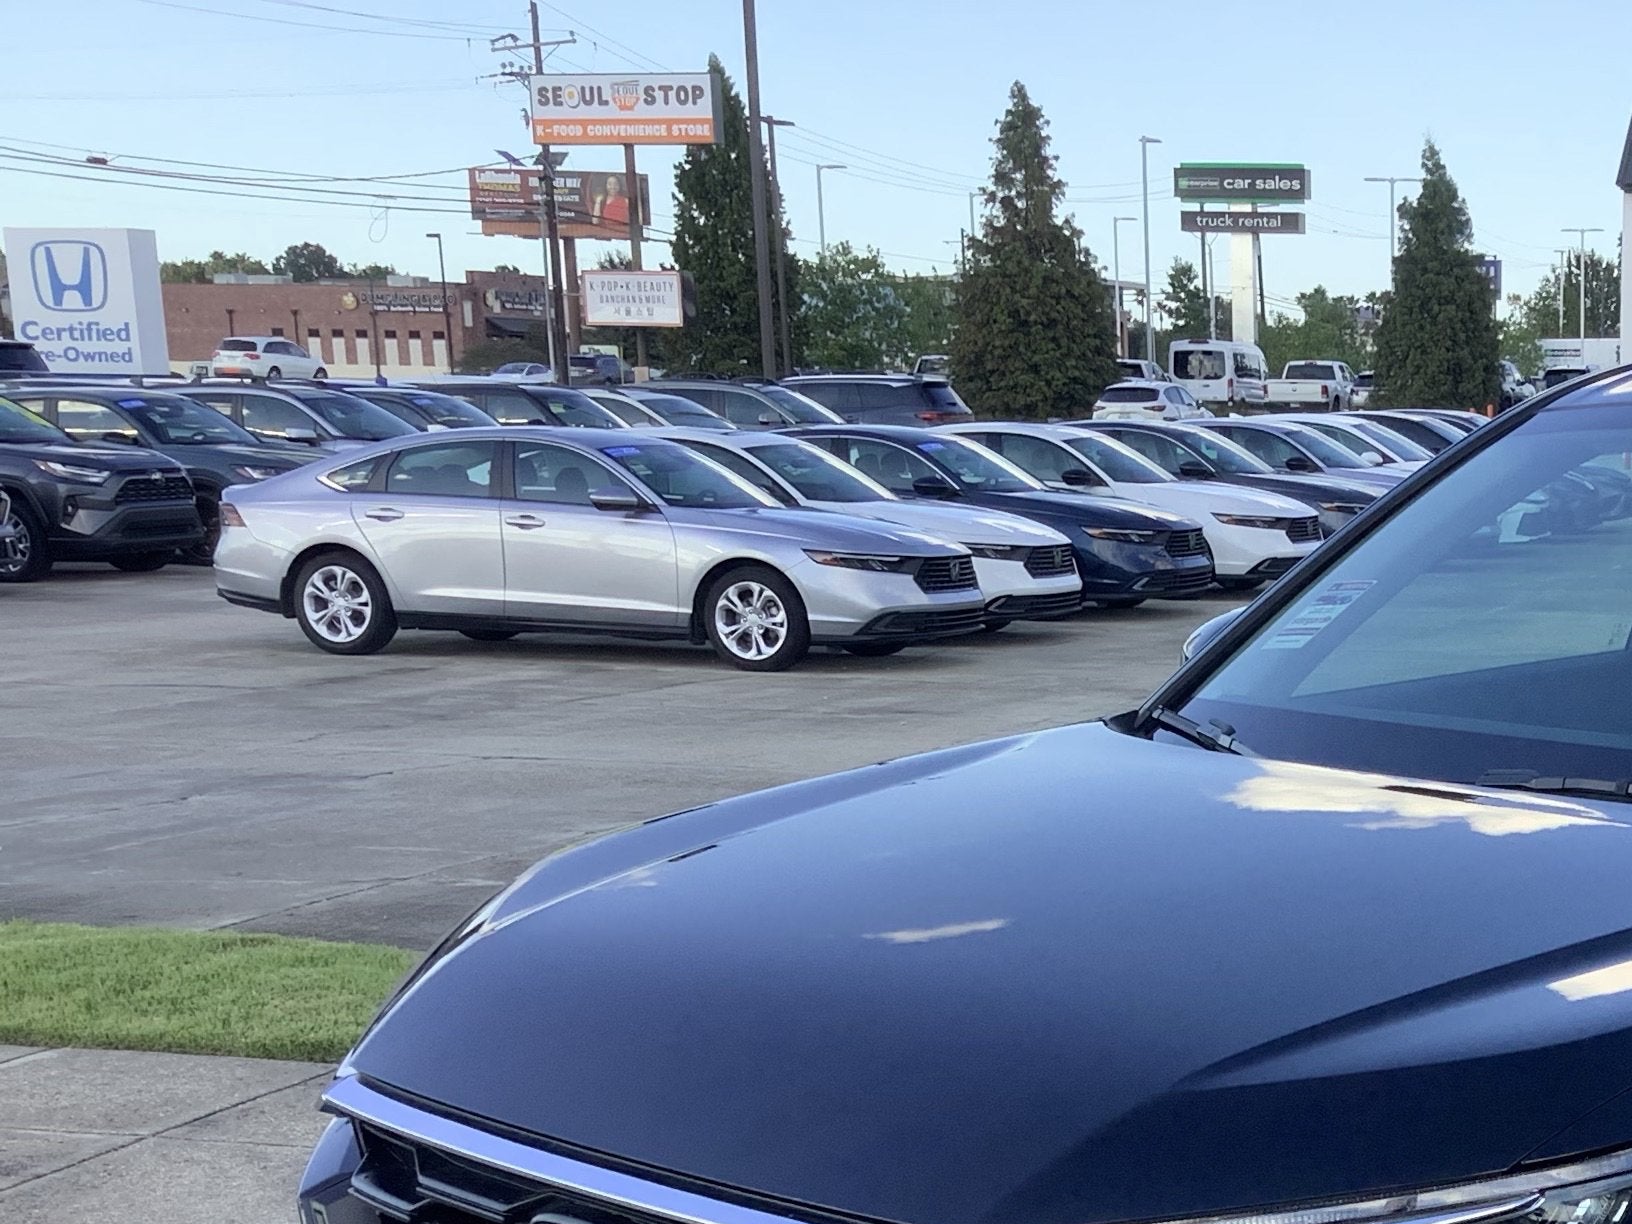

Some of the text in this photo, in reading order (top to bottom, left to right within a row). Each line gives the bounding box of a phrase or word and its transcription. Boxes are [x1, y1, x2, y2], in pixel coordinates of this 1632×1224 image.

[643, 85, 705, 106] STOP
[536, 124, 711, 137] K-FOOD CONVENIENCE STORE
[1223, 178, 1253, 190] car
[1255, 175, 1301, 191] sales
[1195, 214, 1282, 228] truck rental
[20, 320, 132, 342] Certified
[39, 346, 133, 363] re-Owned
